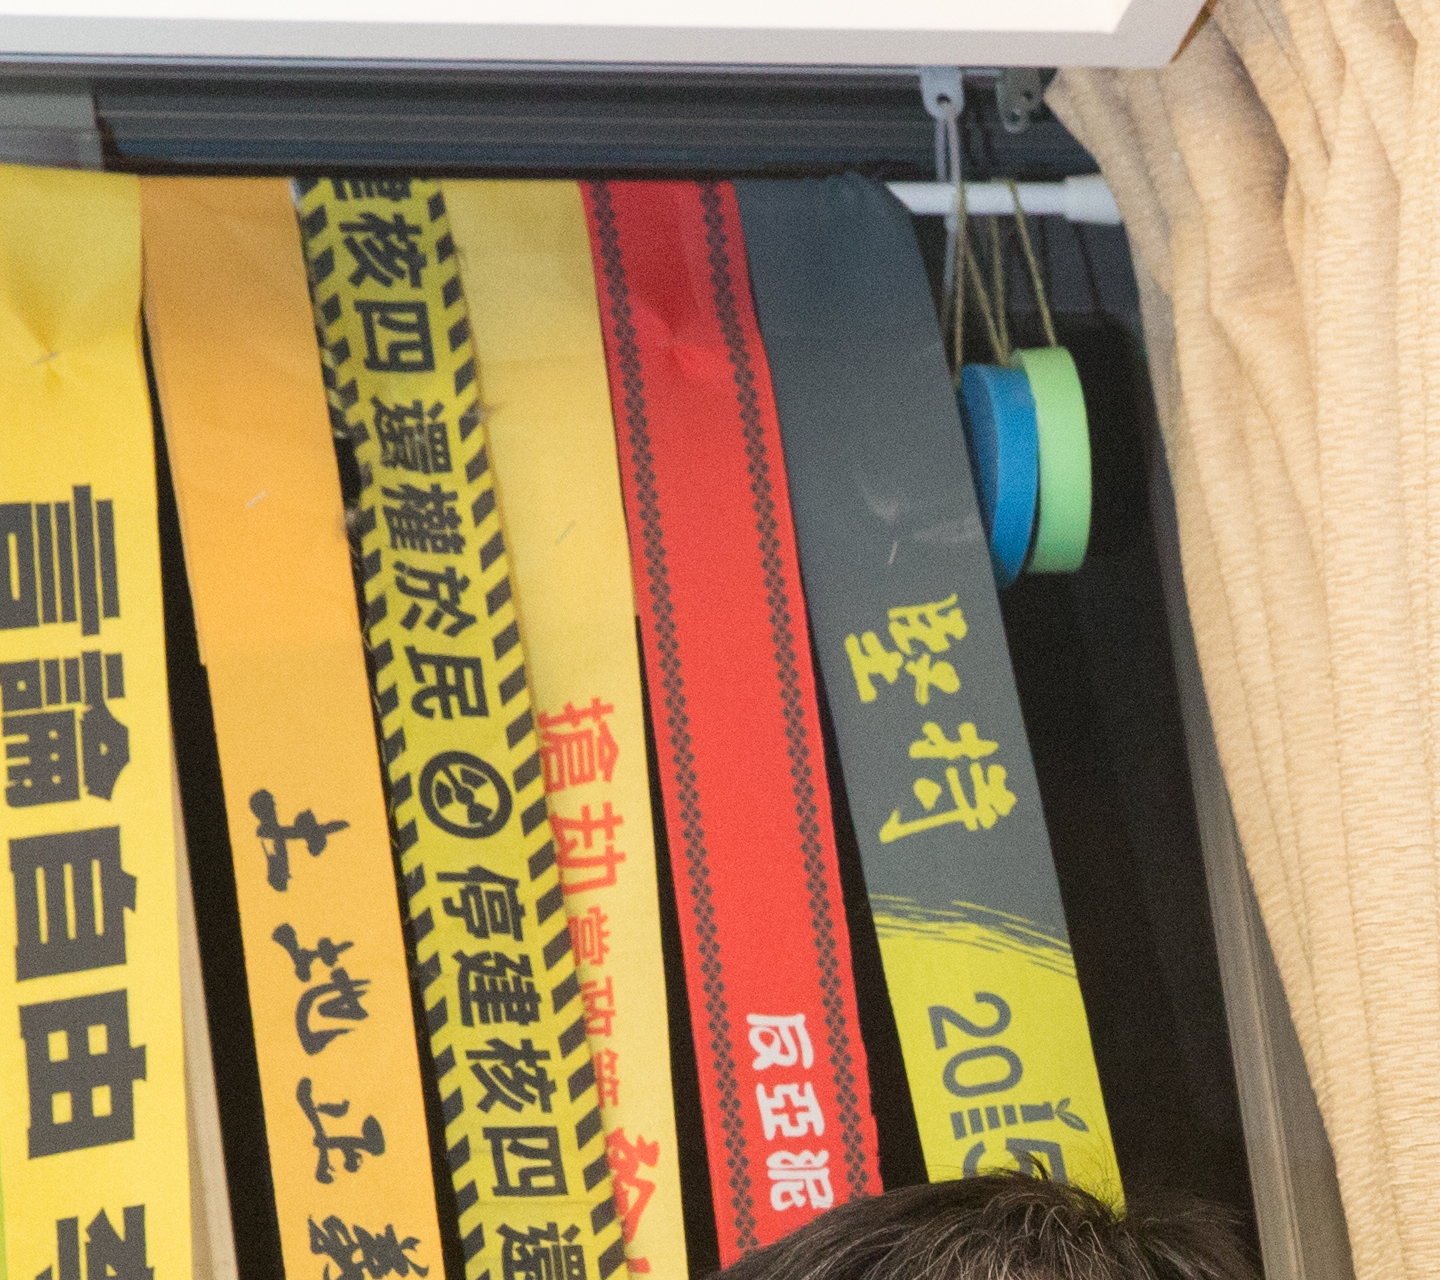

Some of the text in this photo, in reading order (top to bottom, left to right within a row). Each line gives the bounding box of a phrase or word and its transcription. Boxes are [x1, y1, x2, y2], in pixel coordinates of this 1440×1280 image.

[371, 398, 490, 722] 還權於民
[844, 594, 1018, 844] 堅持
[437, 863, 570, 1199] 停建核四
[746, 1012, 835, 1213] 反亞泥
